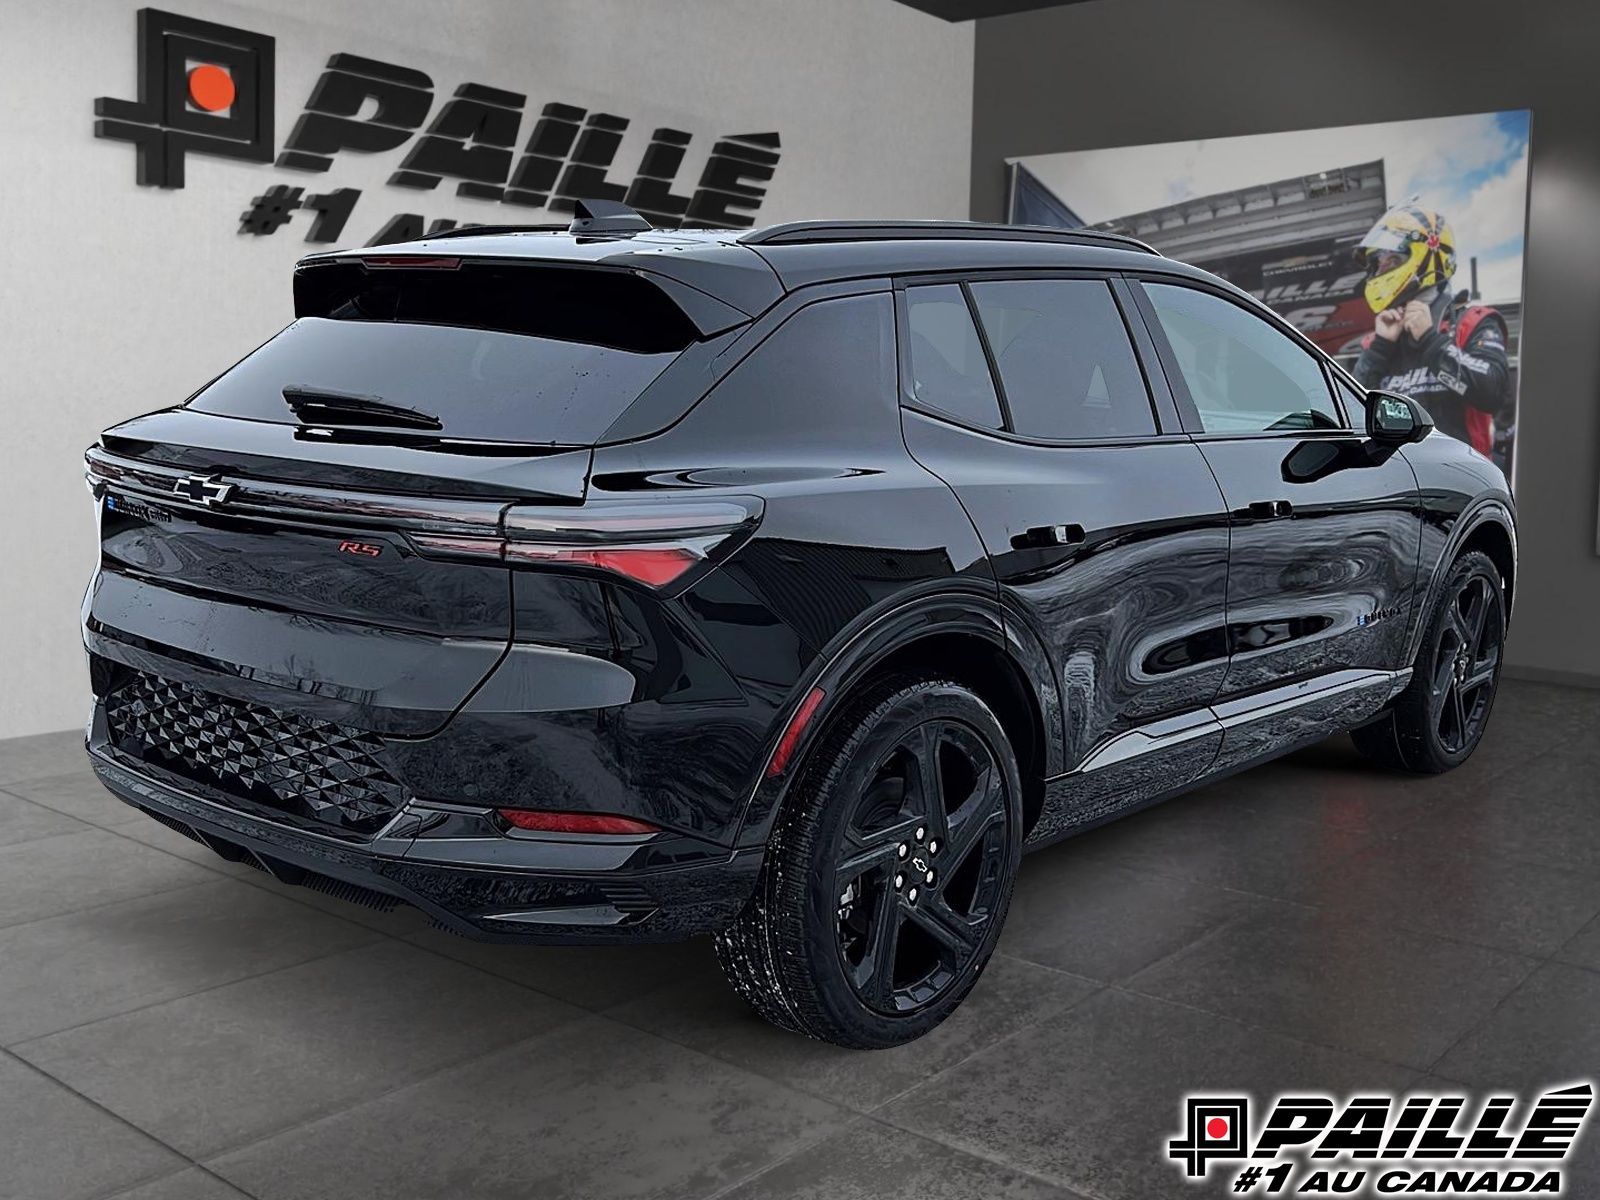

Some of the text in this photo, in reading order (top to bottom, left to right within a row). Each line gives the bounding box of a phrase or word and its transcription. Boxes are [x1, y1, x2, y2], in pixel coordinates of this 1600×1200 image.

[274, 52, 781, 229] PAILLÉ
[237, 184, 363, 243] #1
[339, 541, 381, 557] RS
